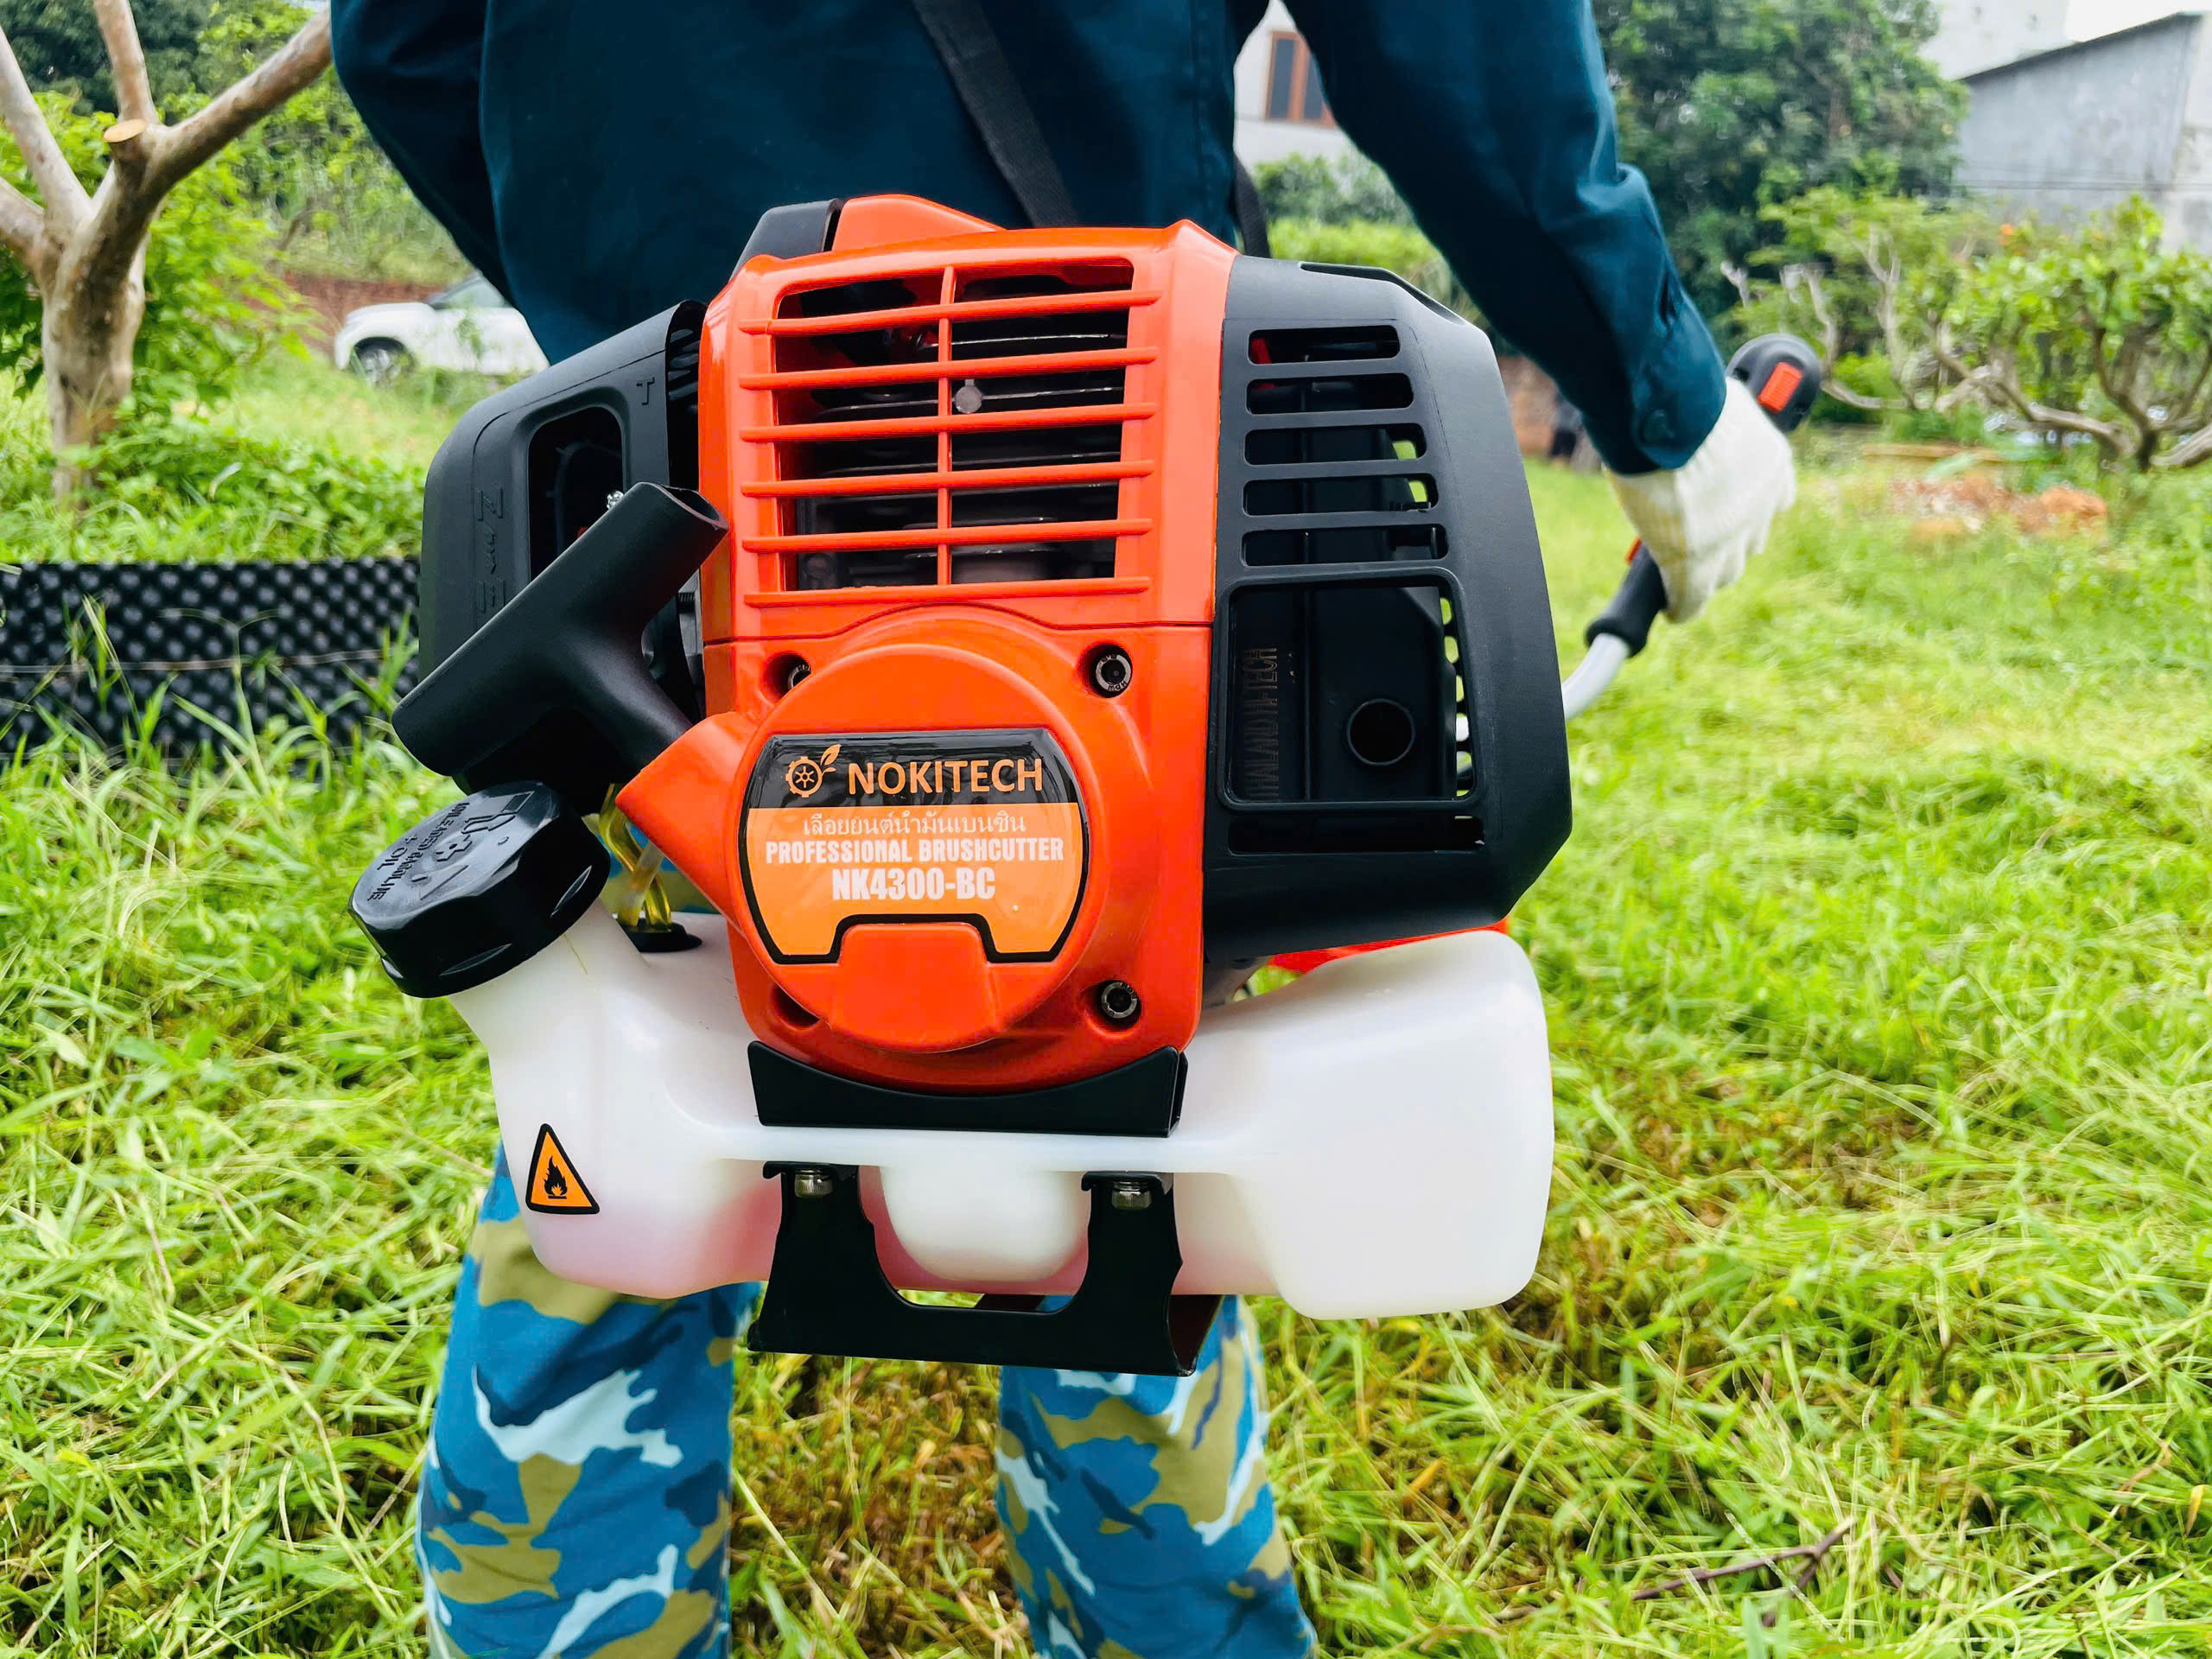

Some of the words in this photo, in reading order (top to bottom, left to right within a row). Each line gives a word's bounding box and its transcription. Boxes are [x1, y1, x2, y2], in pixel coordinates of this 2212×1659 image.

[849, 759, 1043, 795] NOKITECH
[416, 802, 470, 850] UNLEADED
[377, 847, 408, 870] OIL
[766, 841, 912, 864] PROFESSIONAL
[919, 837, 1064, 862] BRUSHCUTTER
[366, 851, 423, 901] GASOLINE
[832, 867, 996, 900] NK4300-BC
